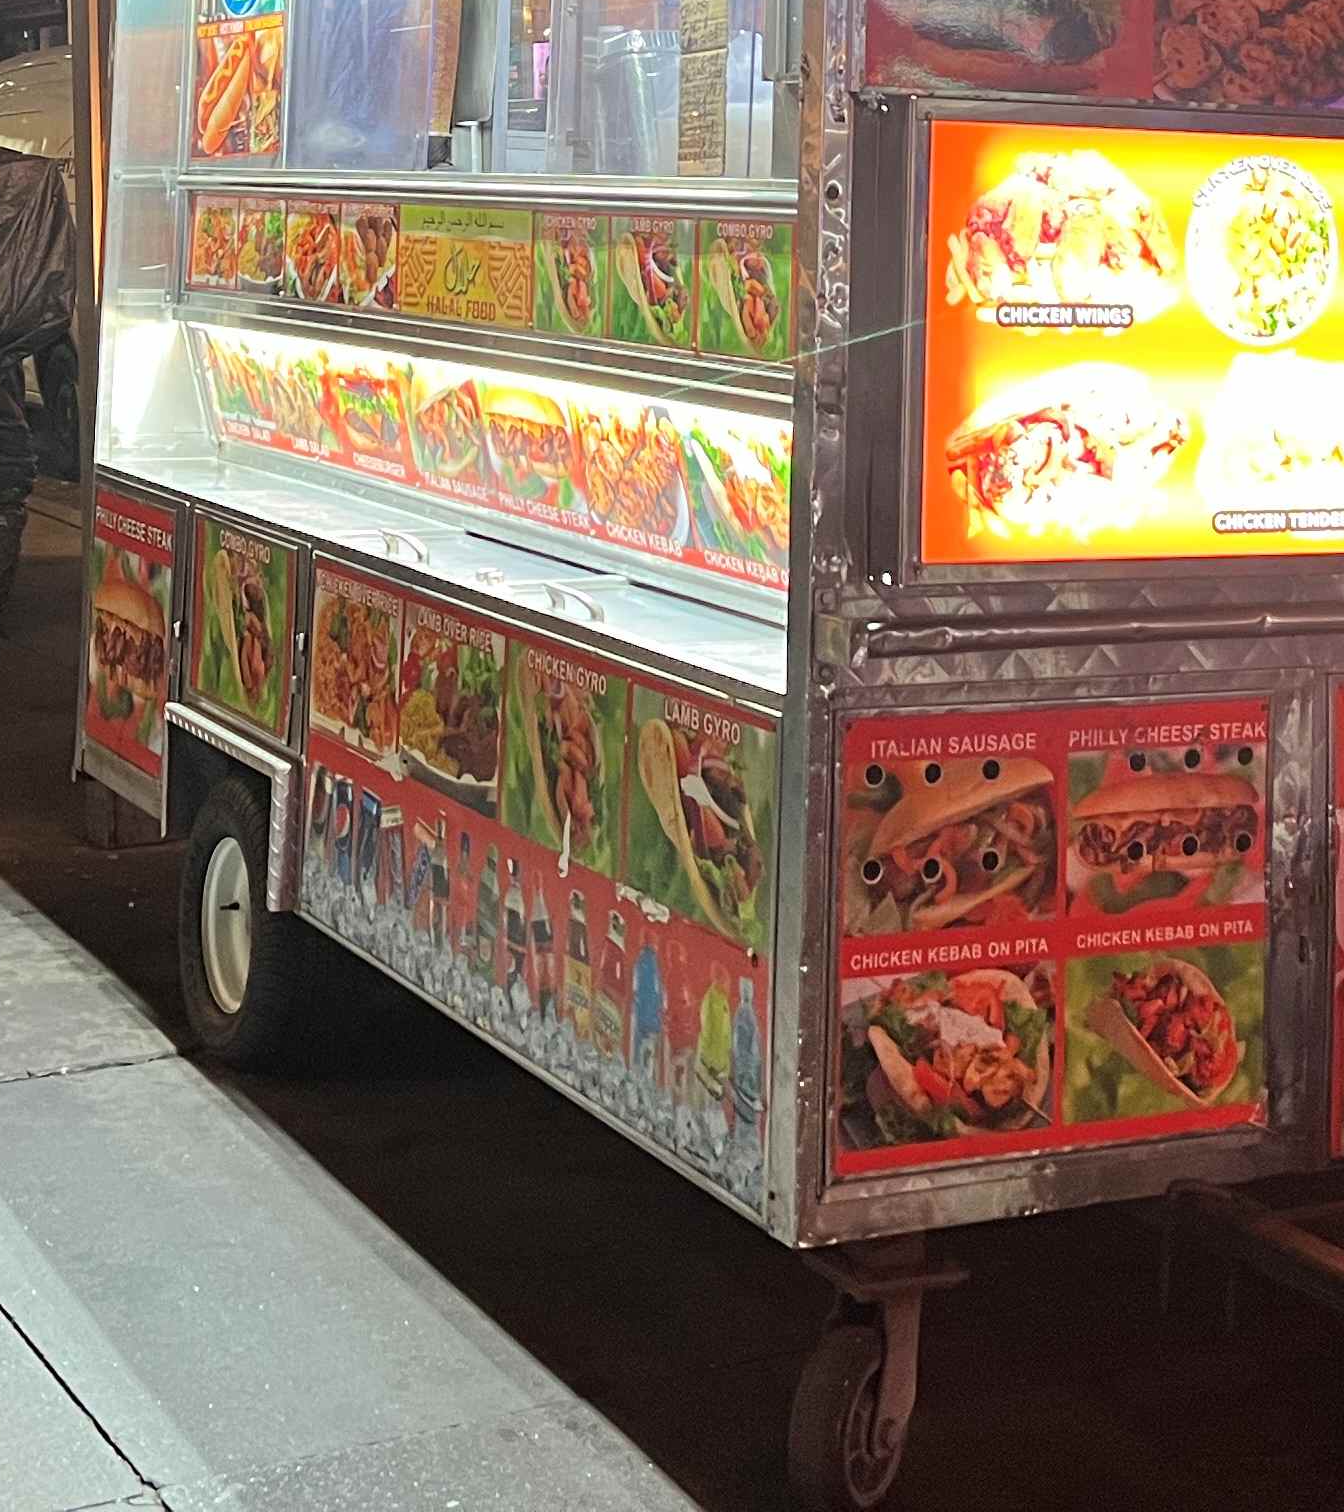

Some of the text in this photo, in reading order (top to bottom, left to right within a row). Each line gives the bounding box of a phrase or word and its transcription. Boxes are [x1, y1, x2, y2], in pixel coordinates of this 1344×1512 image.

[652, 219, 674, 234] GYRO
[716, 221, 774, 240] COMBO GYRO
[465, 299, 497, 322] FOOD
[998, 304, 1133, 328] CHICKEN WINGS
[95, 504, 173, 553] PHILLY CHEESE STEAK
[525, 496, 561, 521] CHEESE
[561, 506, 591, 530] STEAK
[1215, 511, 1287, 533] CHICKEN
[219, 528, 272, 565] COMBO GYRO
[606, 520, 684, 557] CHICKEN KEBAB
[703, 549, 745, 575] CHICKEN
[744, 559, 778, 584] KEBAB
[417, 607, 493, 654] LAMB OVER RICE
[527, 648, 607, 696] CHICKEN GYRO
[664, 695, 741, 746] LAMB GYRO
[1068, 727, 1129, 748] PHILLY
[1208, 720, 1266, 742] STEAK
[871, 731, 1038, 759] ITALIAN SAUSAGE
[1075, 919, 1254, 949] CHICKEN KEBAB ON PITA
[850, 937, 1049, 971] CHICKEN KEBAB ON PITA
